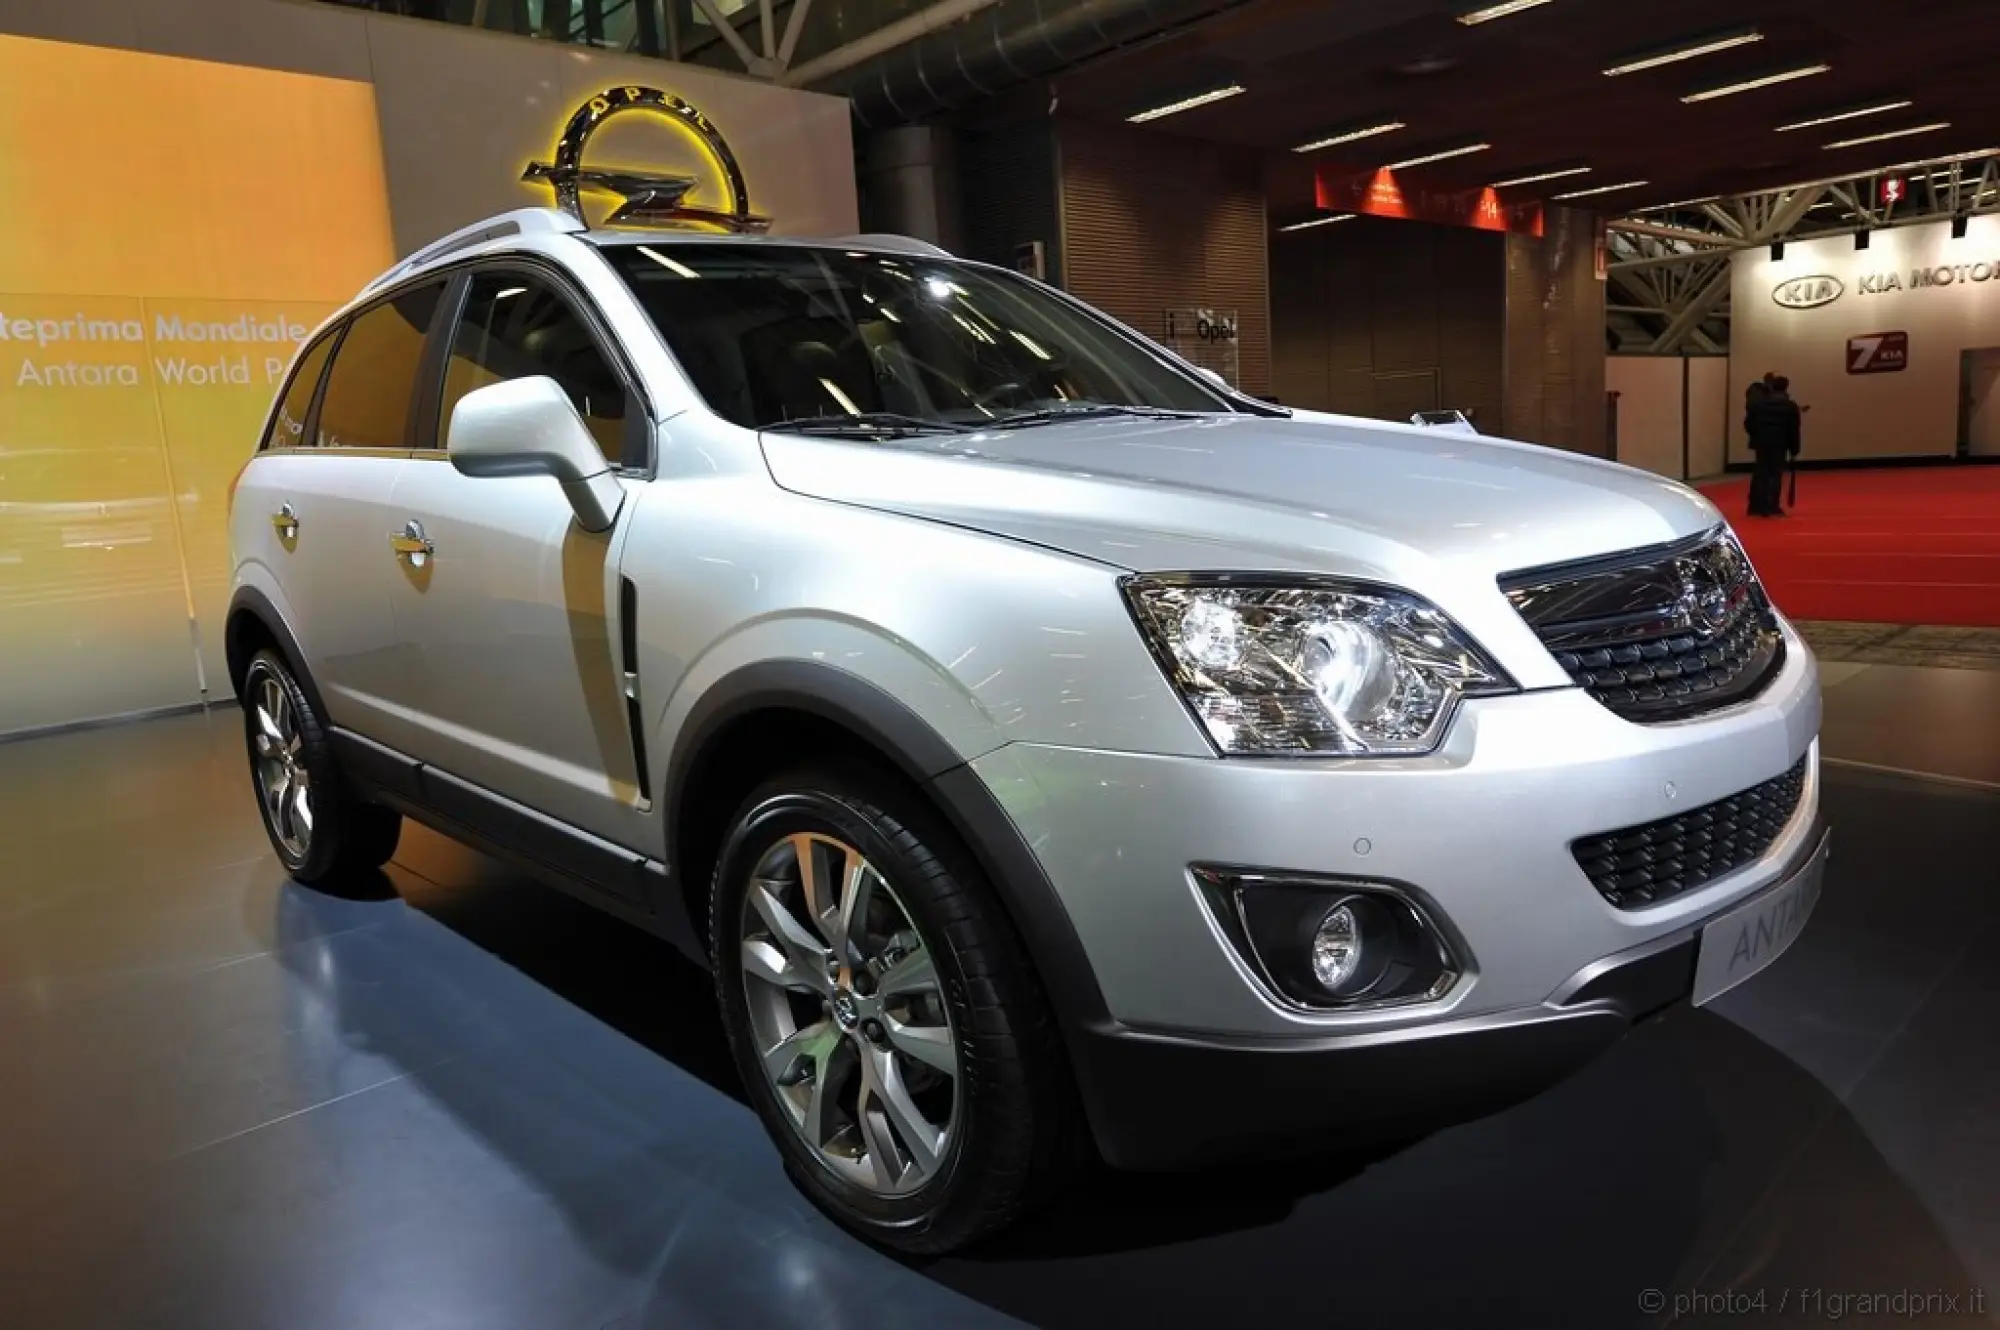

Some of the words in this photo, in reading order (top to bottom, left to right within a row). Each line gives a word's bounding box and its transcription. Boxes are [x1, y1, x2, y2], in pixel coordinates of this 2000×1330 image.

[1784, 280, 1833, 302] KIA
[1858, 271, 1902, 295] KIA
[155, 313, 308, 343] Mondiale
[1198, 318, 1235, 345] Opel
[1850, 336, 1883, 371] 7
[1880, 349, 1905, 361] KIA
[17, 358, 139, 387] Antara
[154, 357, 251, 385] World
